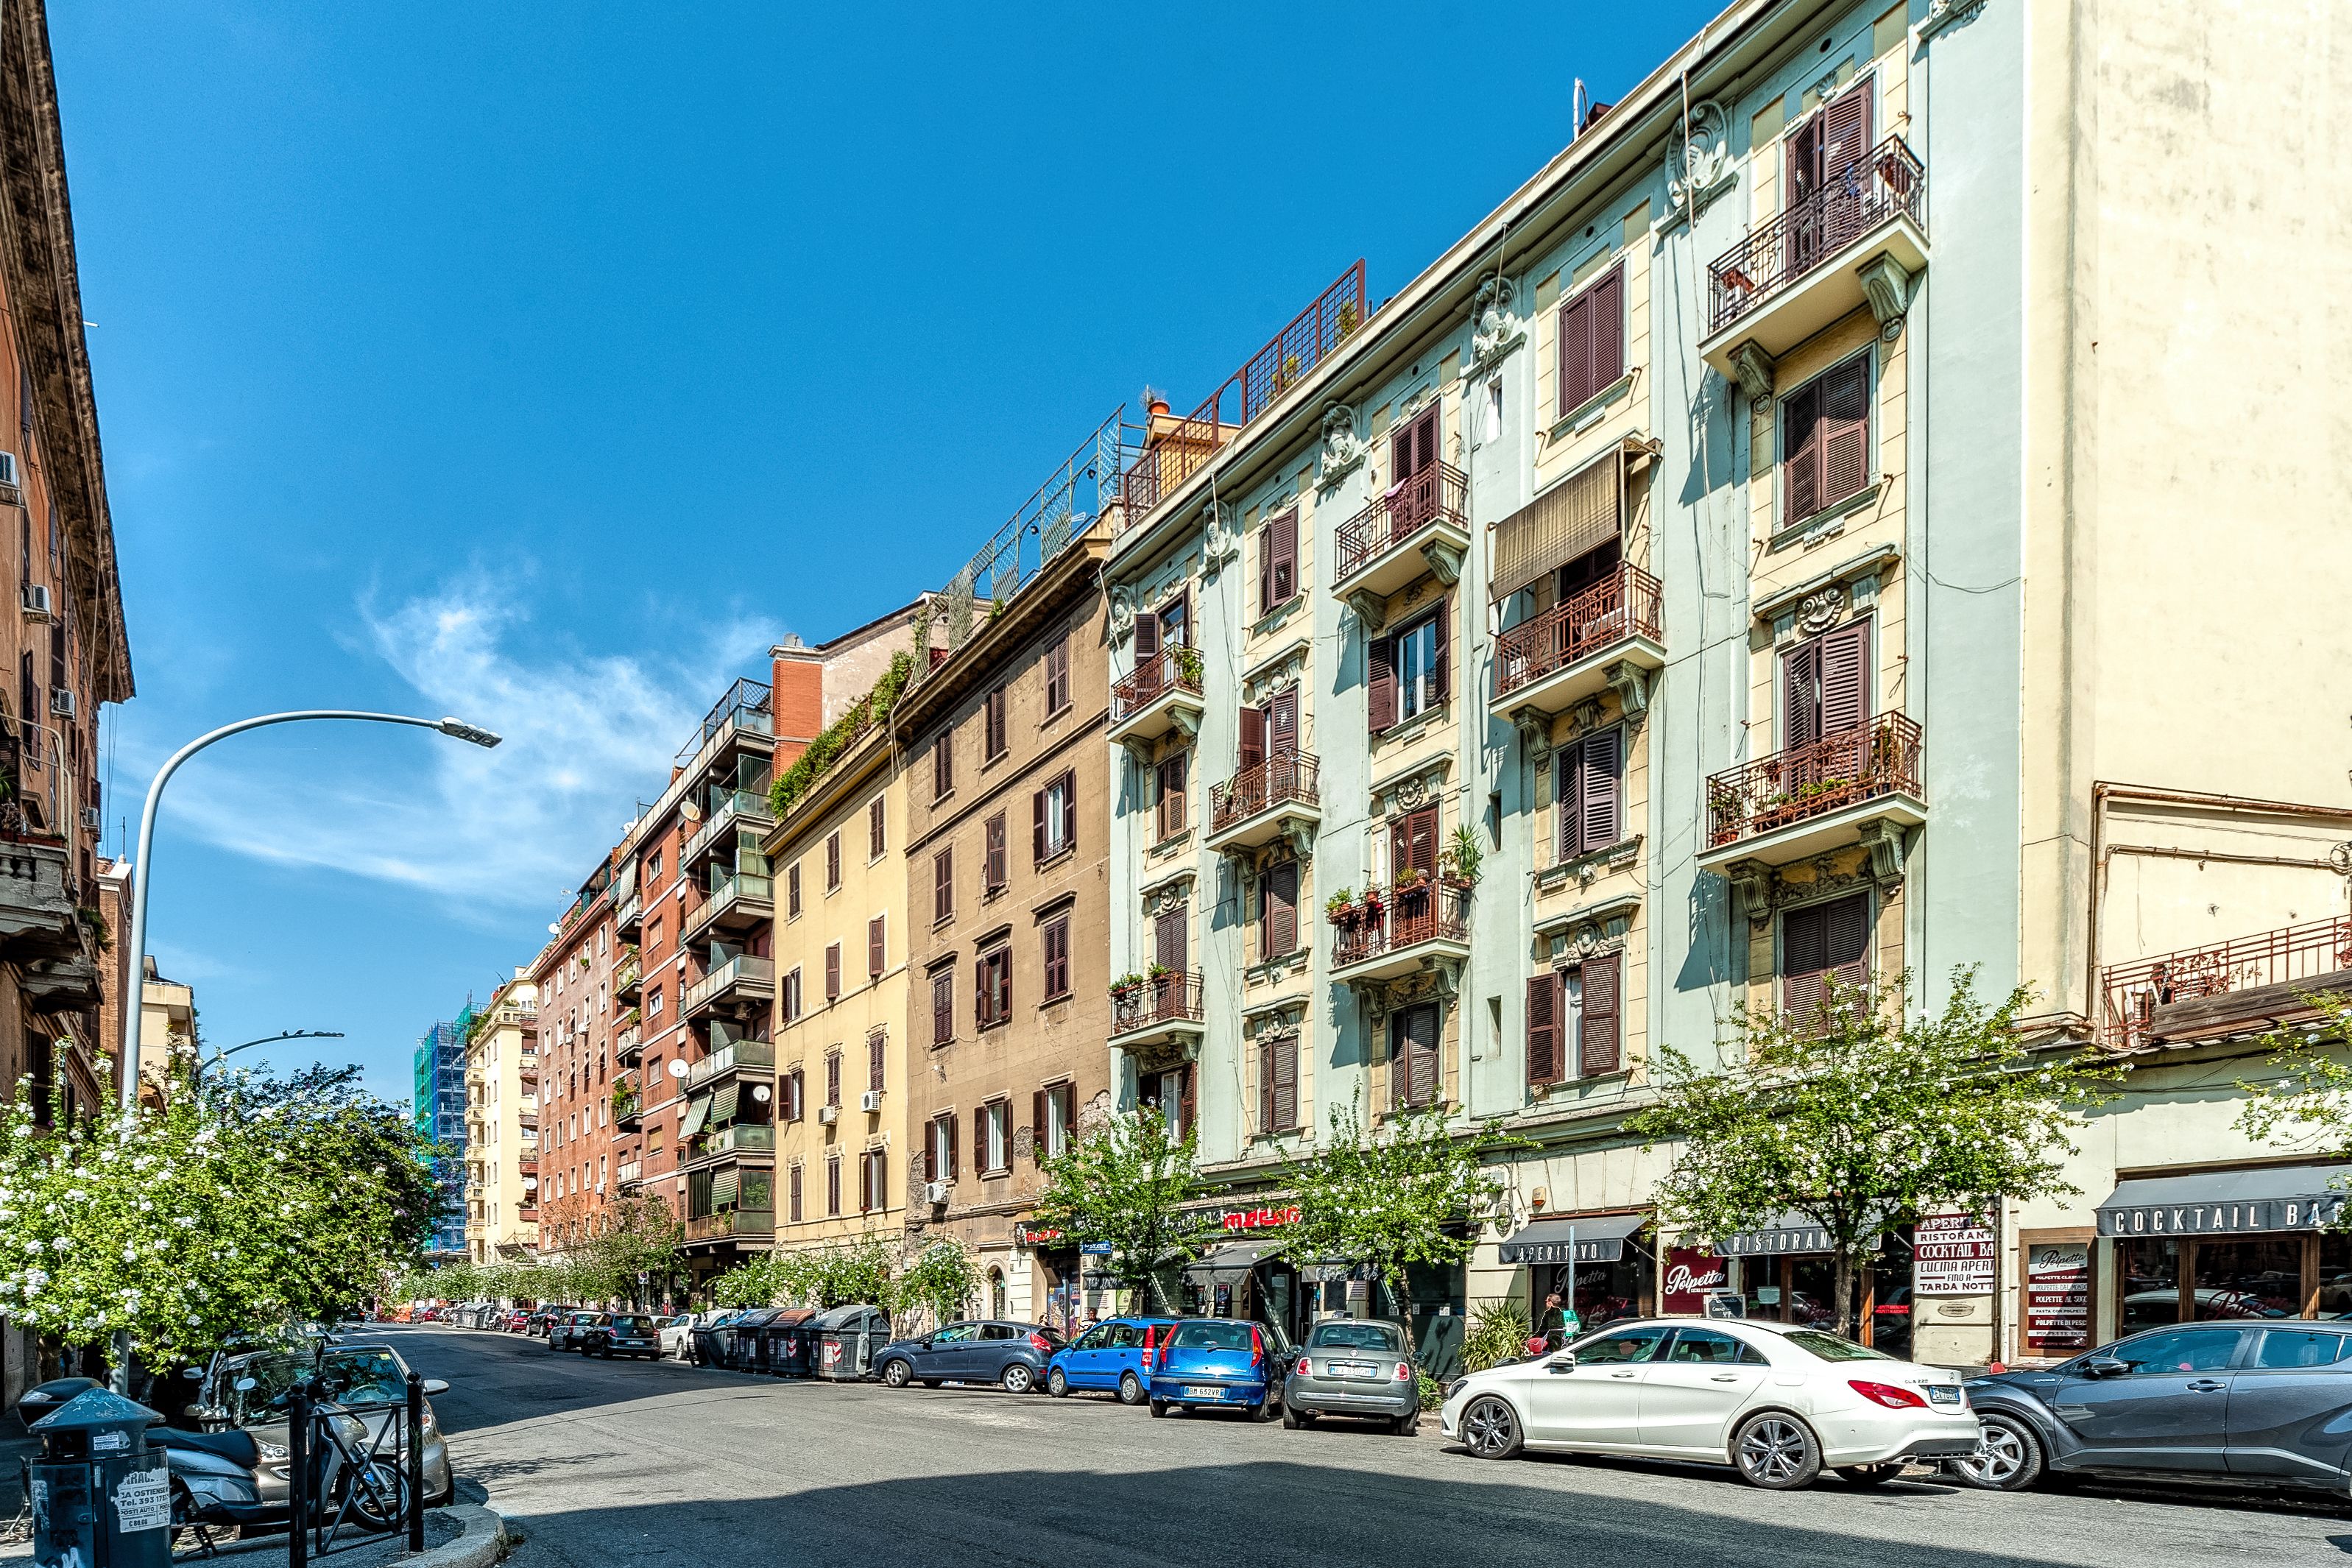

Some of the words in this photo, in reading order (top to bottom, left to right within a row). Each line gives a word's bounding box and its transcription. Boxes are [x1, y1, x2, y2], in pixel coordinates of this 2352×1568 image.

[2116, 1206, 2259, 1232] COCKTAIL
[1921, 1232, 1991, 1241] RISTORAN
[1919, 1243, 1974, 1258] COCKTAIL
[1920, 1261, 1957, 1272] CUCINA
[2039, 1250, 2086, 1269] Polpetta
[1665, 1265, 1725, 1294] Polpetta
[139, 1497, 154, 1505] 393
